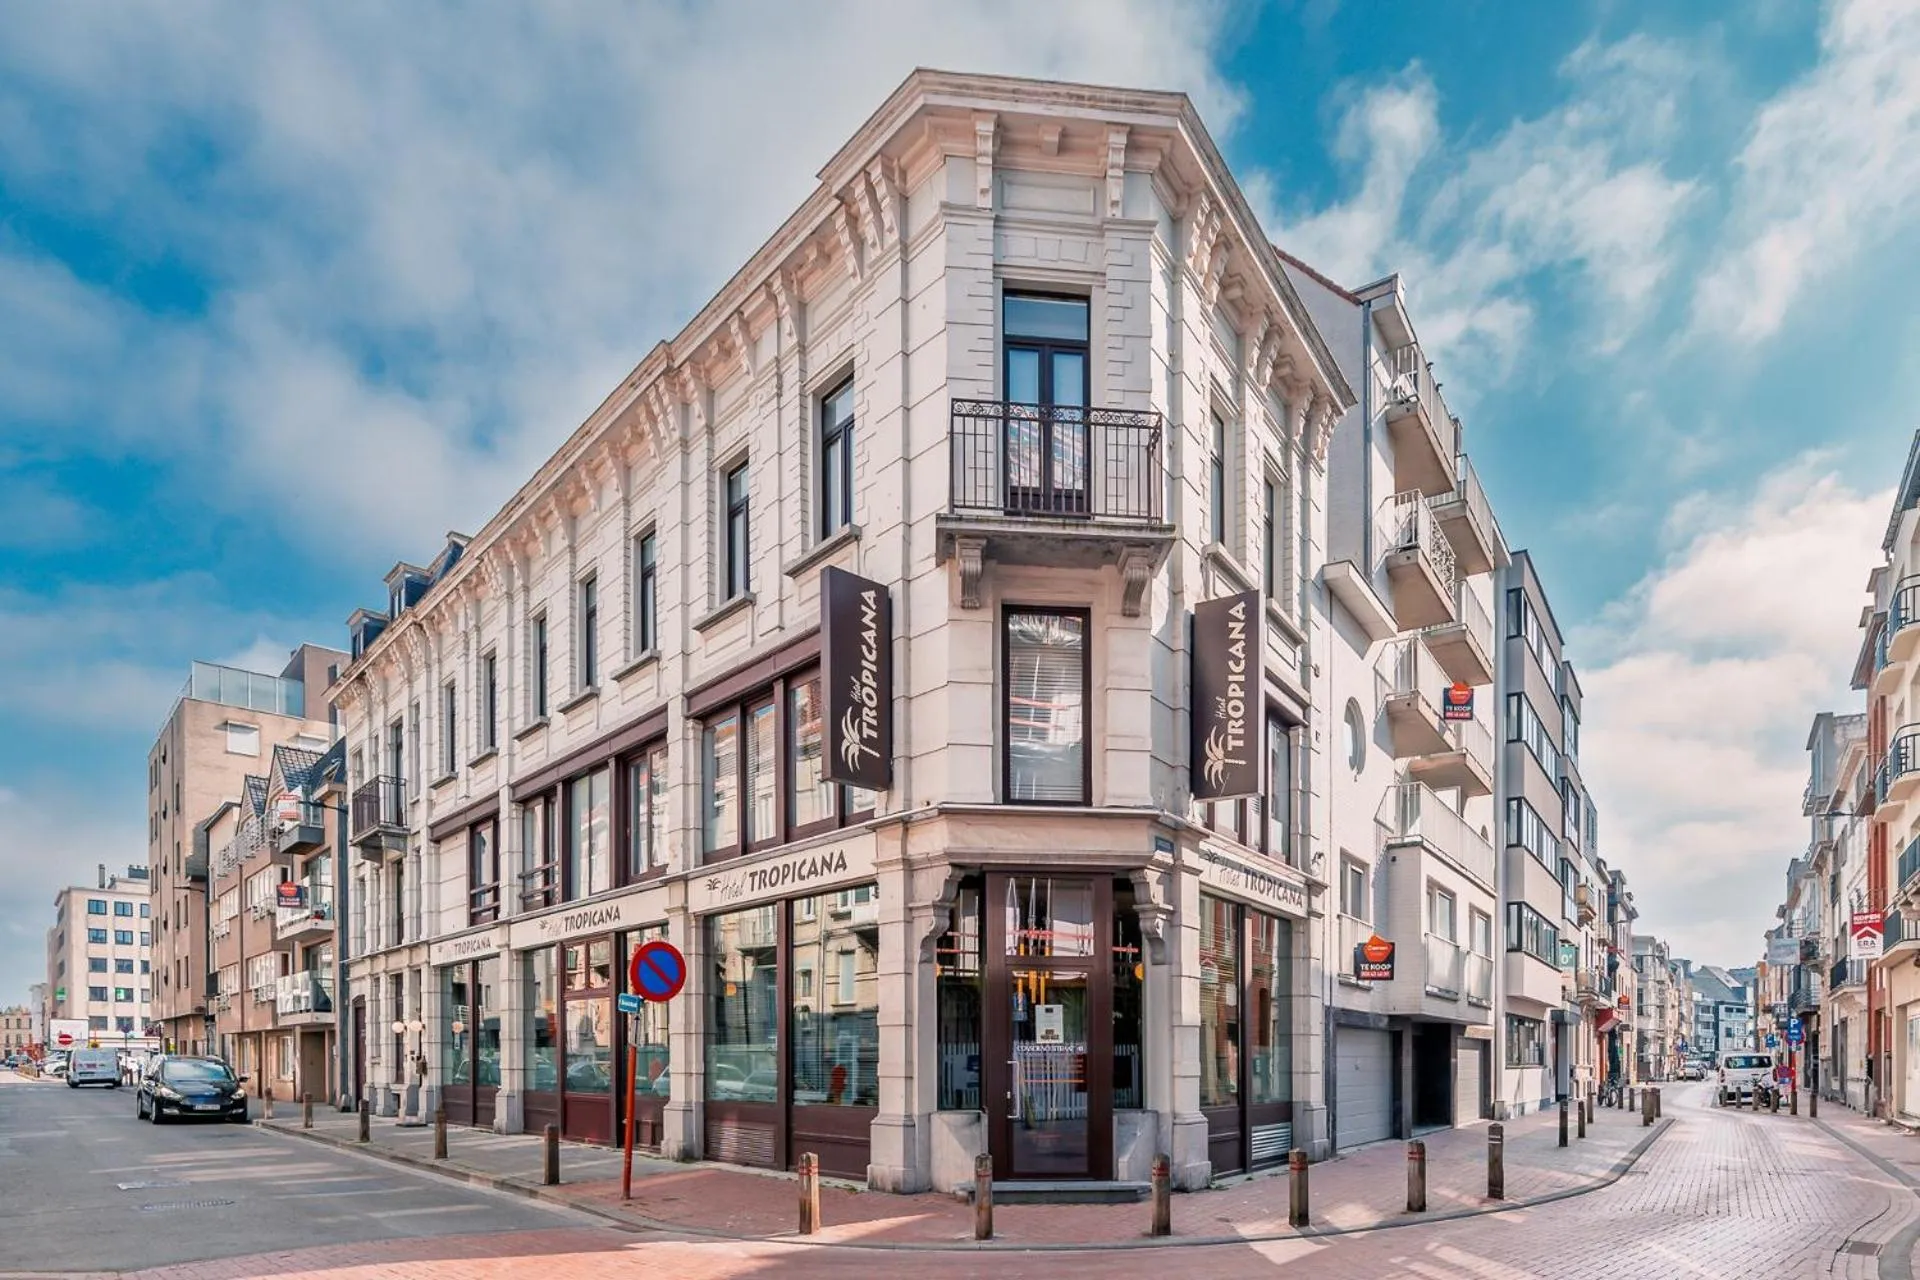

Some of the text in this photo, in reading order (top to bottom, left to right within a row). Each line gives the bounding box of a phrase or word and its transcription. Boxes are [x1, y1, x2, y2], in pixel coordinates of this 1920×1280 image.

[861, 590, 877, 738] TROPICANA
[1215, 601, 1246, 751] Hotel TROPICANA
[720, 850, 847, 900] Hotel TROPICANA
[1243, 868, 1303, 908] TROPICANA
[564, 905, 621, 932] TROPICANA
[454, 936, 491, 955] TROPICANA
[1790, 1018, 1798, 1028] P
